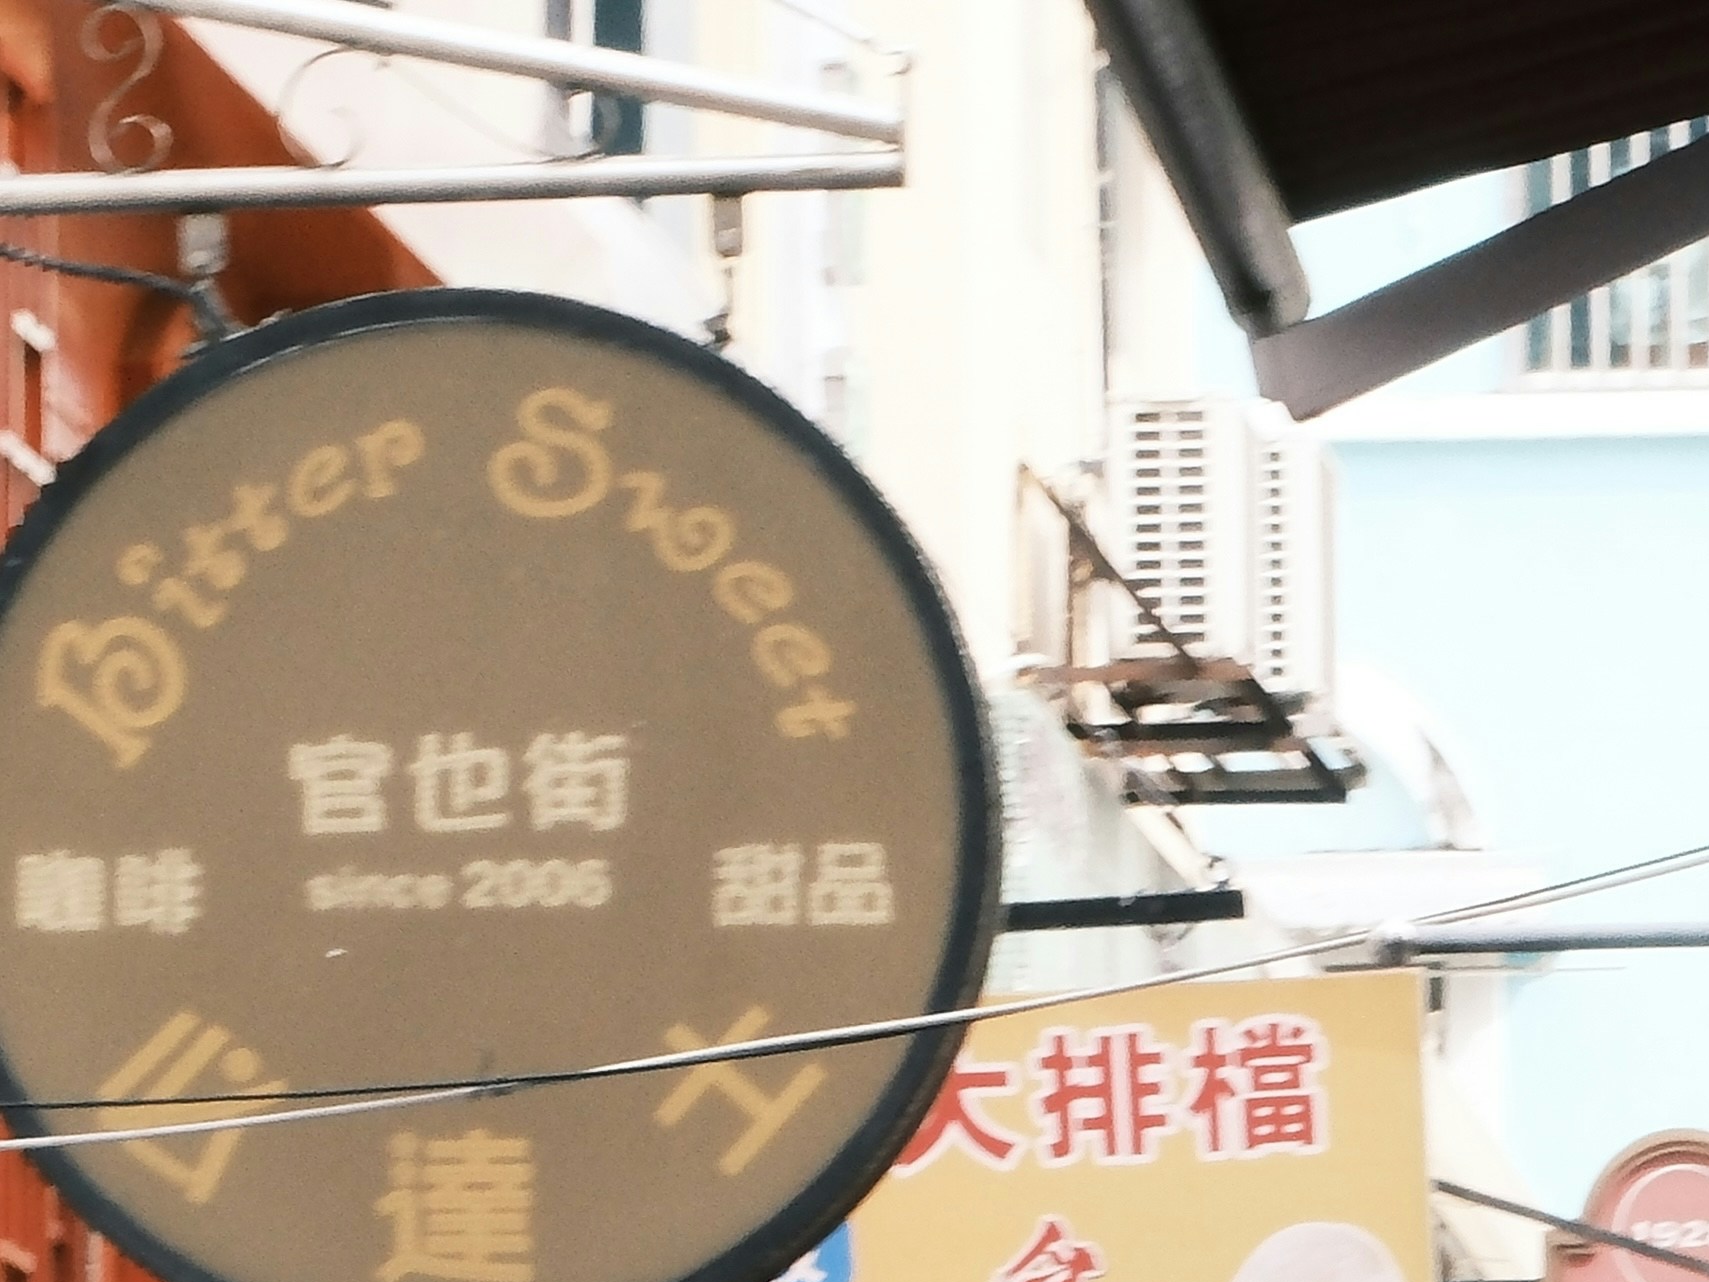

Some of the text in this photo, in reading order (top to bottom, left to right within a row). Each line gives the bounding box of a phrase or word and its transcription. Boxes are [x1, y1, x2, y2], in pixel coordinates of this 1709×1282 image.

[36, 387, 860, 770] Bitter Sweet
[288, 732, 634, 836] 官也街
[304, 866, 453, 913] since
[711, 842, 897, 928] 甜品
